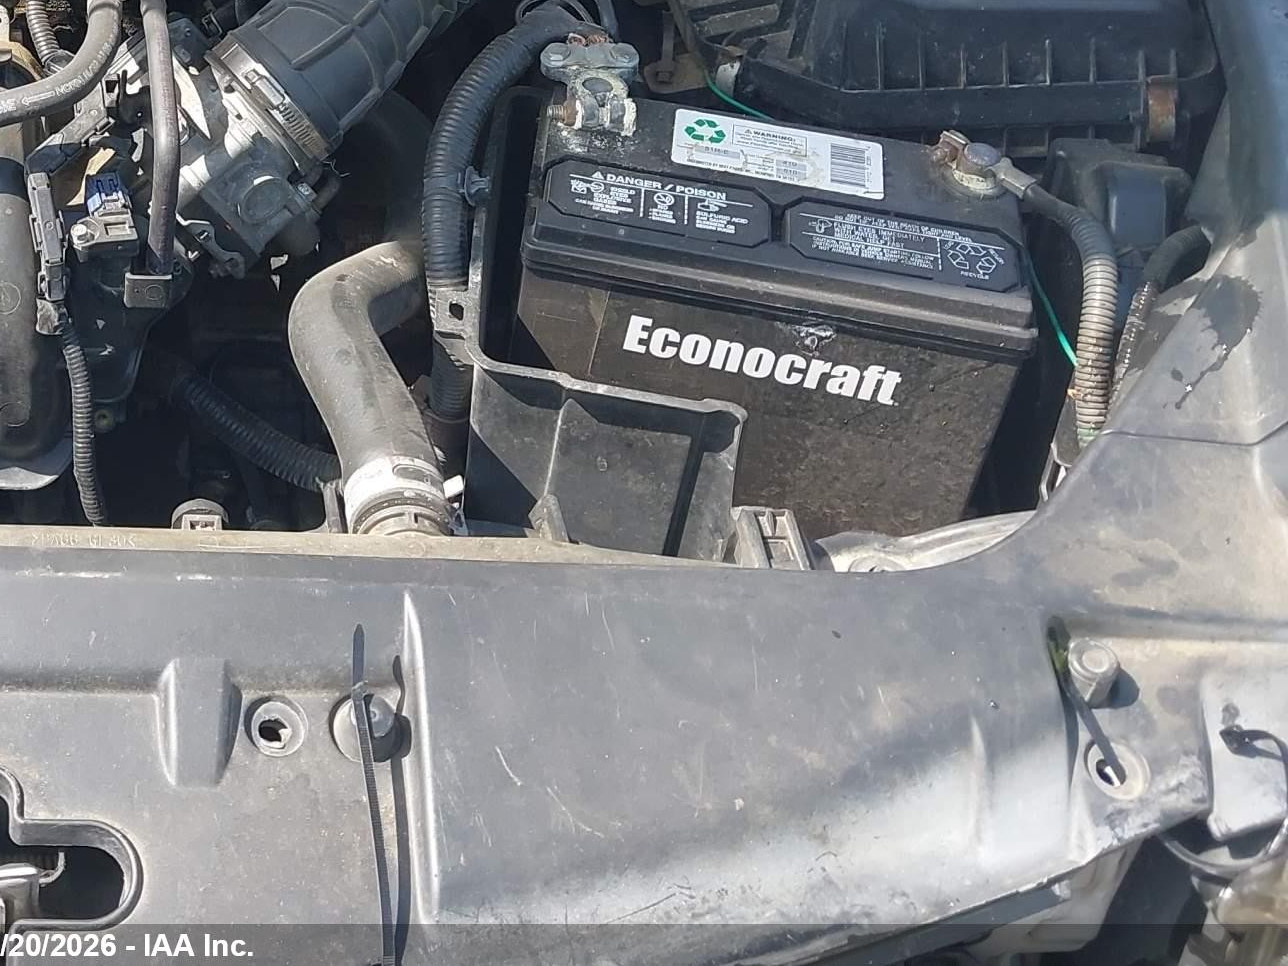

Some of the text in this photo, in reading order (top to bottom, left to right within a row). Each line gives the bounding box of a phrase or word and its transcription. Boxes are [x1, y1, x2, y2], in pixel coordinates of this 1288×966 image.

[606, 173, 662, 189] DANGER
[675, 185, 727, 201] POISON
[623, 315, 902, 406] Econocraft
